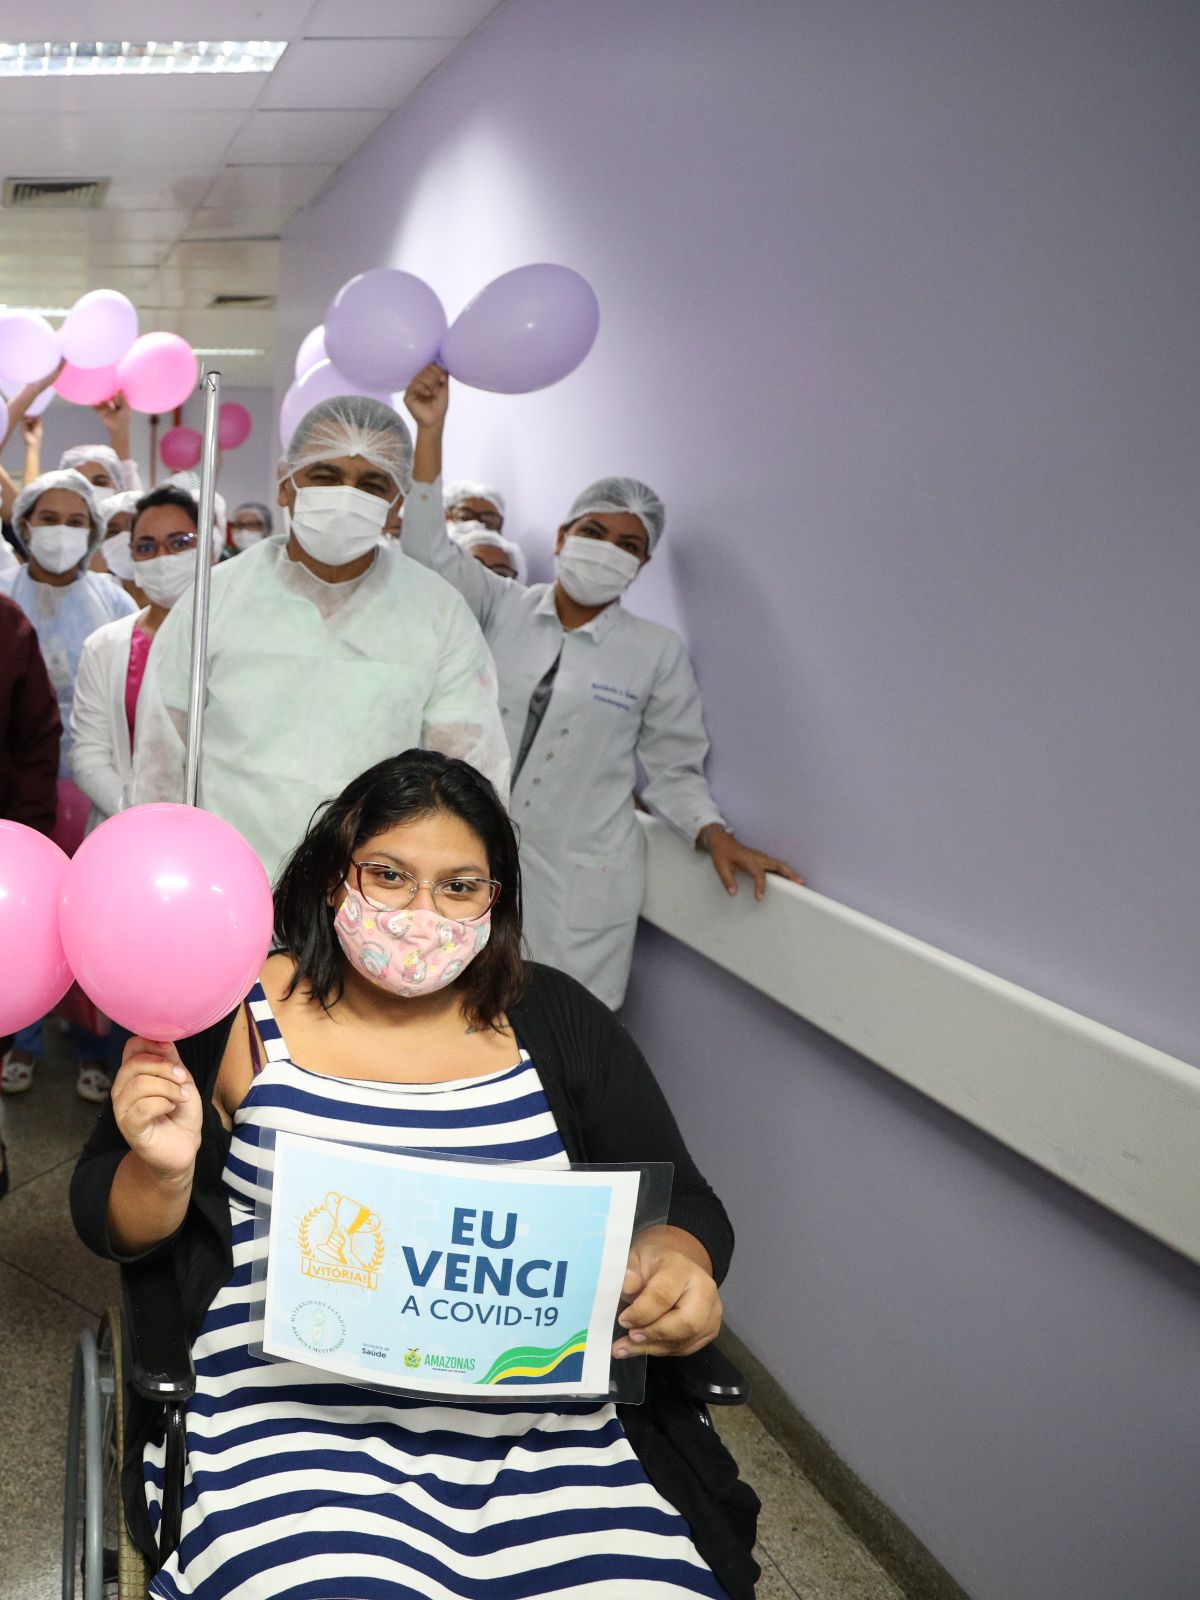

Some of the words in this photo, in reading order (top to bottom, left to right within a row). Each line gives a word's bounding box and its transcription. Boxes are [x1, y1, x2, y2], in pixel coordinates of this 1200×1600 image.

[450, 1206, 518, 1250] EU
[401, 1245, 569, 1299] VENCI
[401, 1295, 421, 1318] A
[429, 1298, 559, 1327] COVID-19
[361, 1347, 387, 1359] Saúde
[424, 1353, 476, 1371] AMAZONAS
